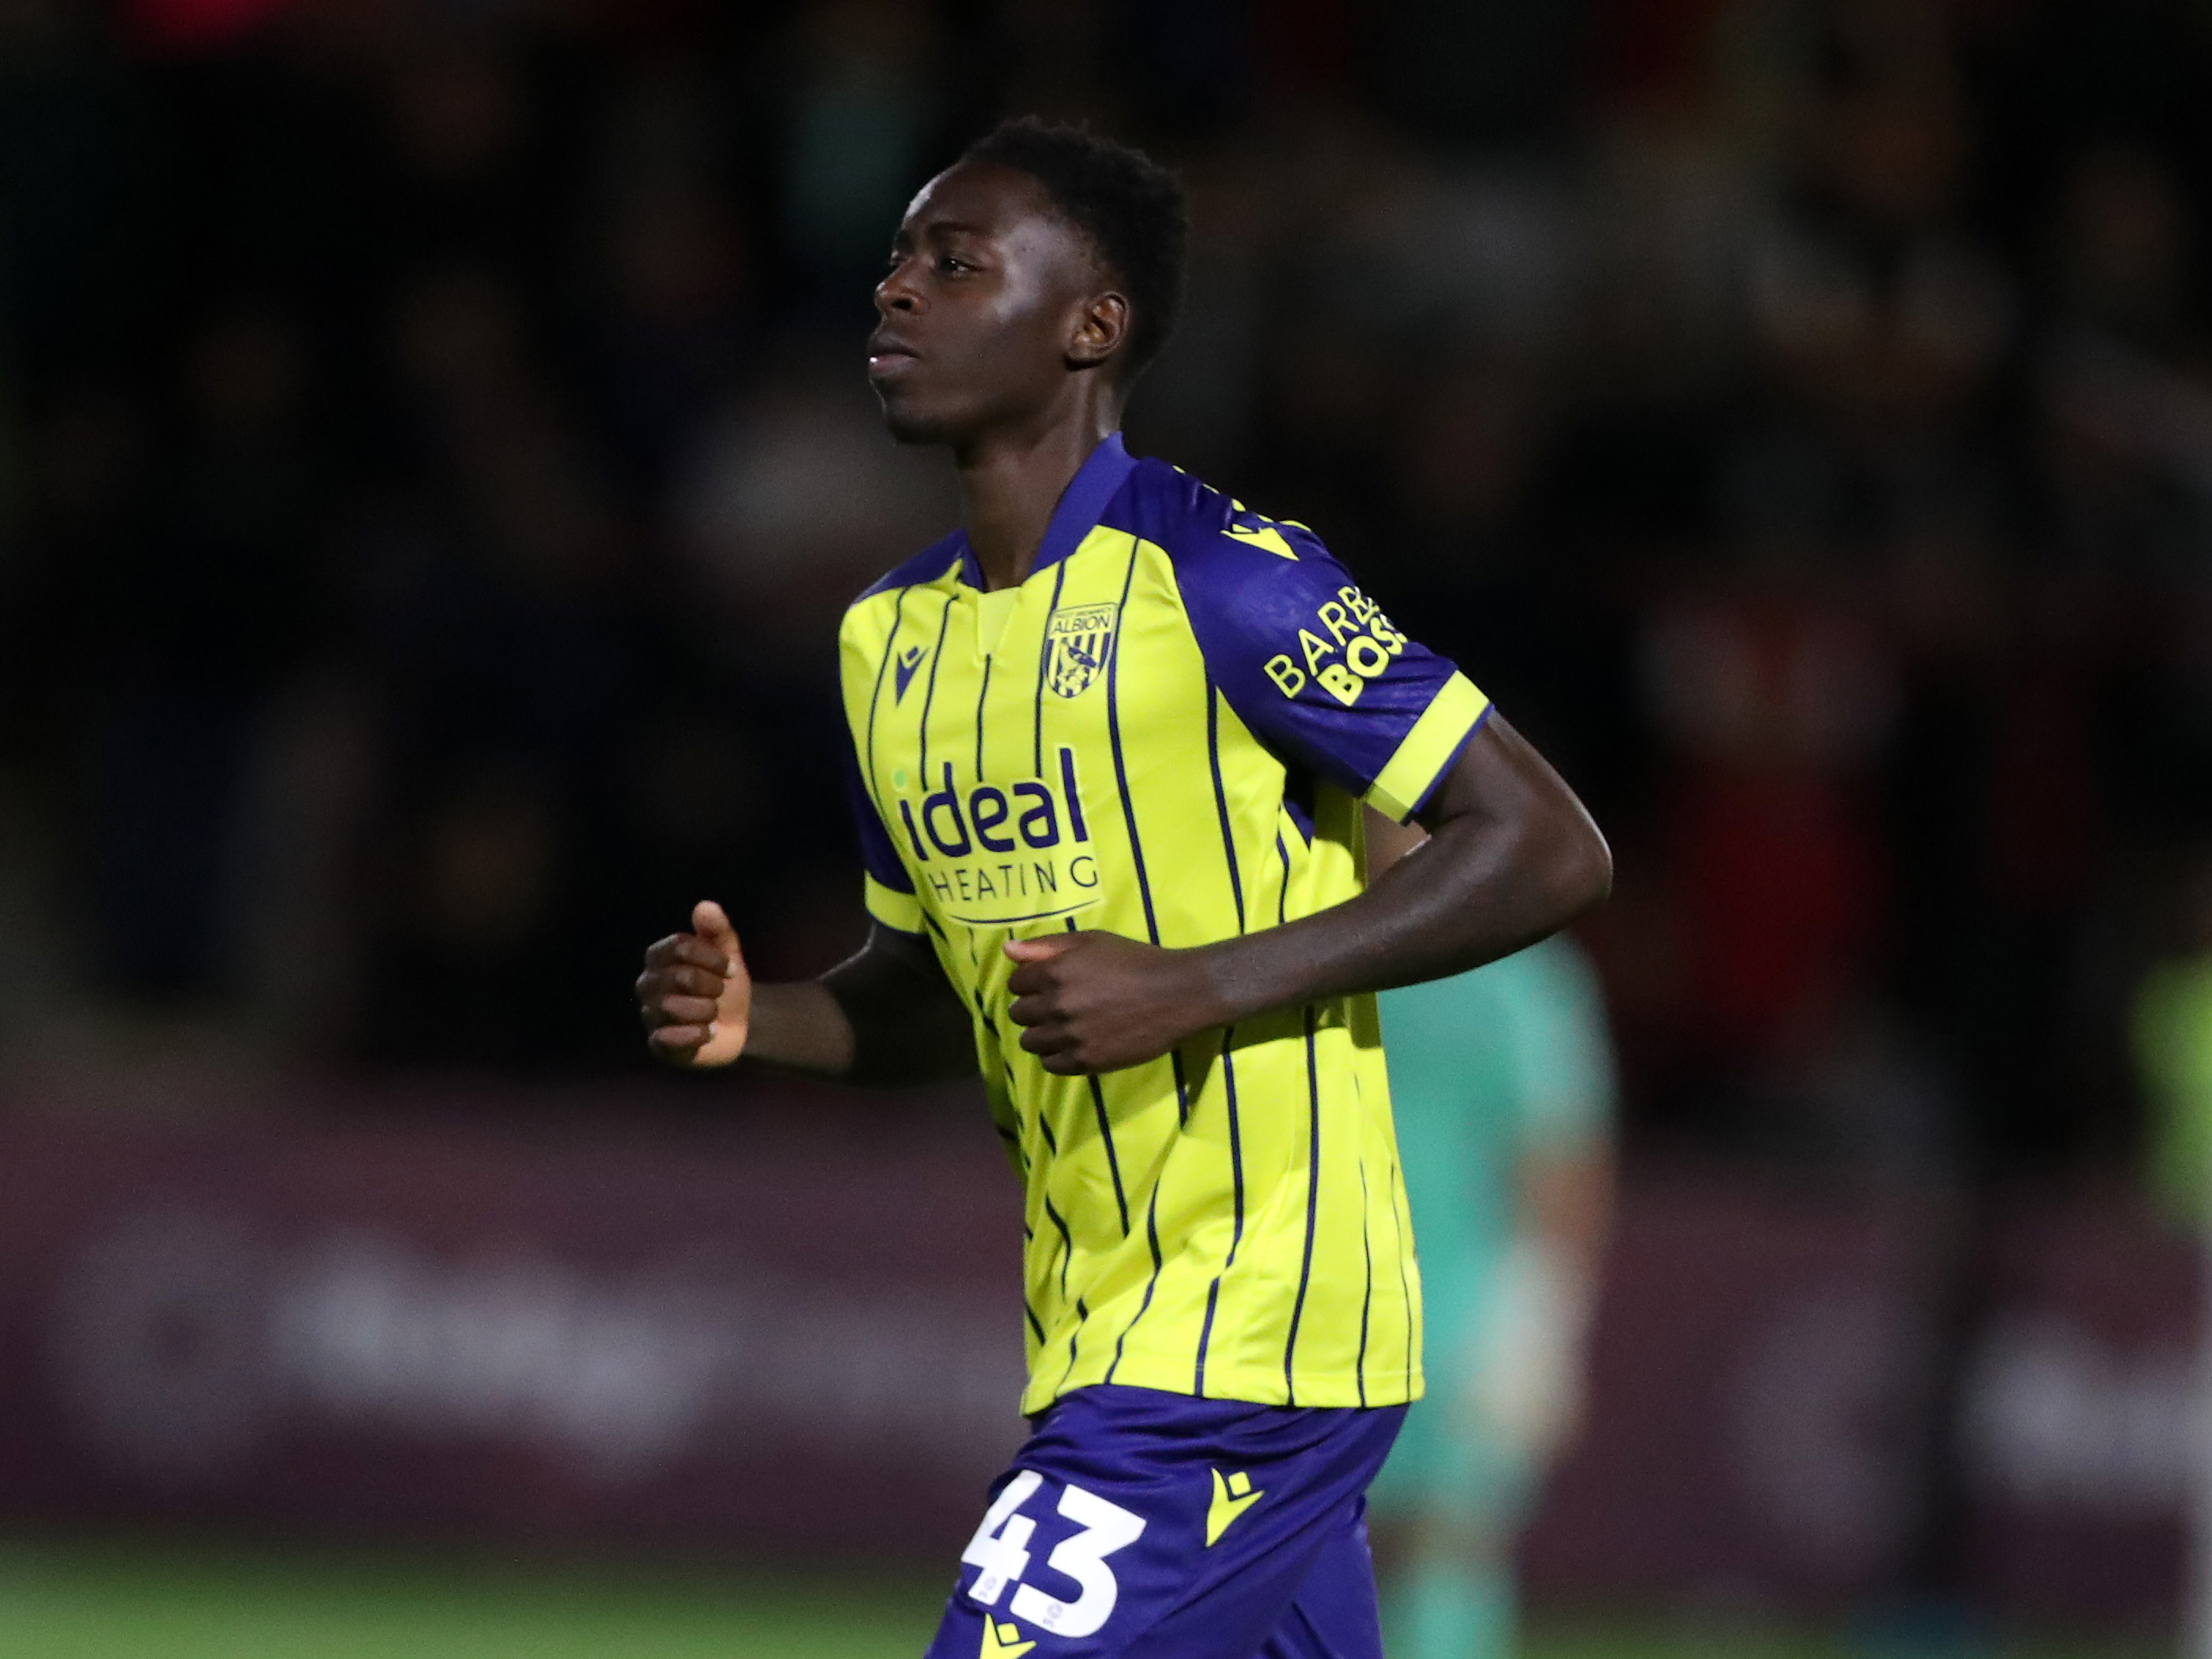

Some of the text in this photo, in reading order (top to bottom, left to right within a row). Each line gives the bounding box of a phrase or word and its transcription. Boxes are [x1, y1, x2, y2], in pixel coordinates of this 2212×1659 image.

[1055, 616, 1110, 633] ALBION
[893, 747, 1089, 861] ideal
[927, 856, 1098, 902] HEATING
[961, 1469, 1147, 1639] 43
